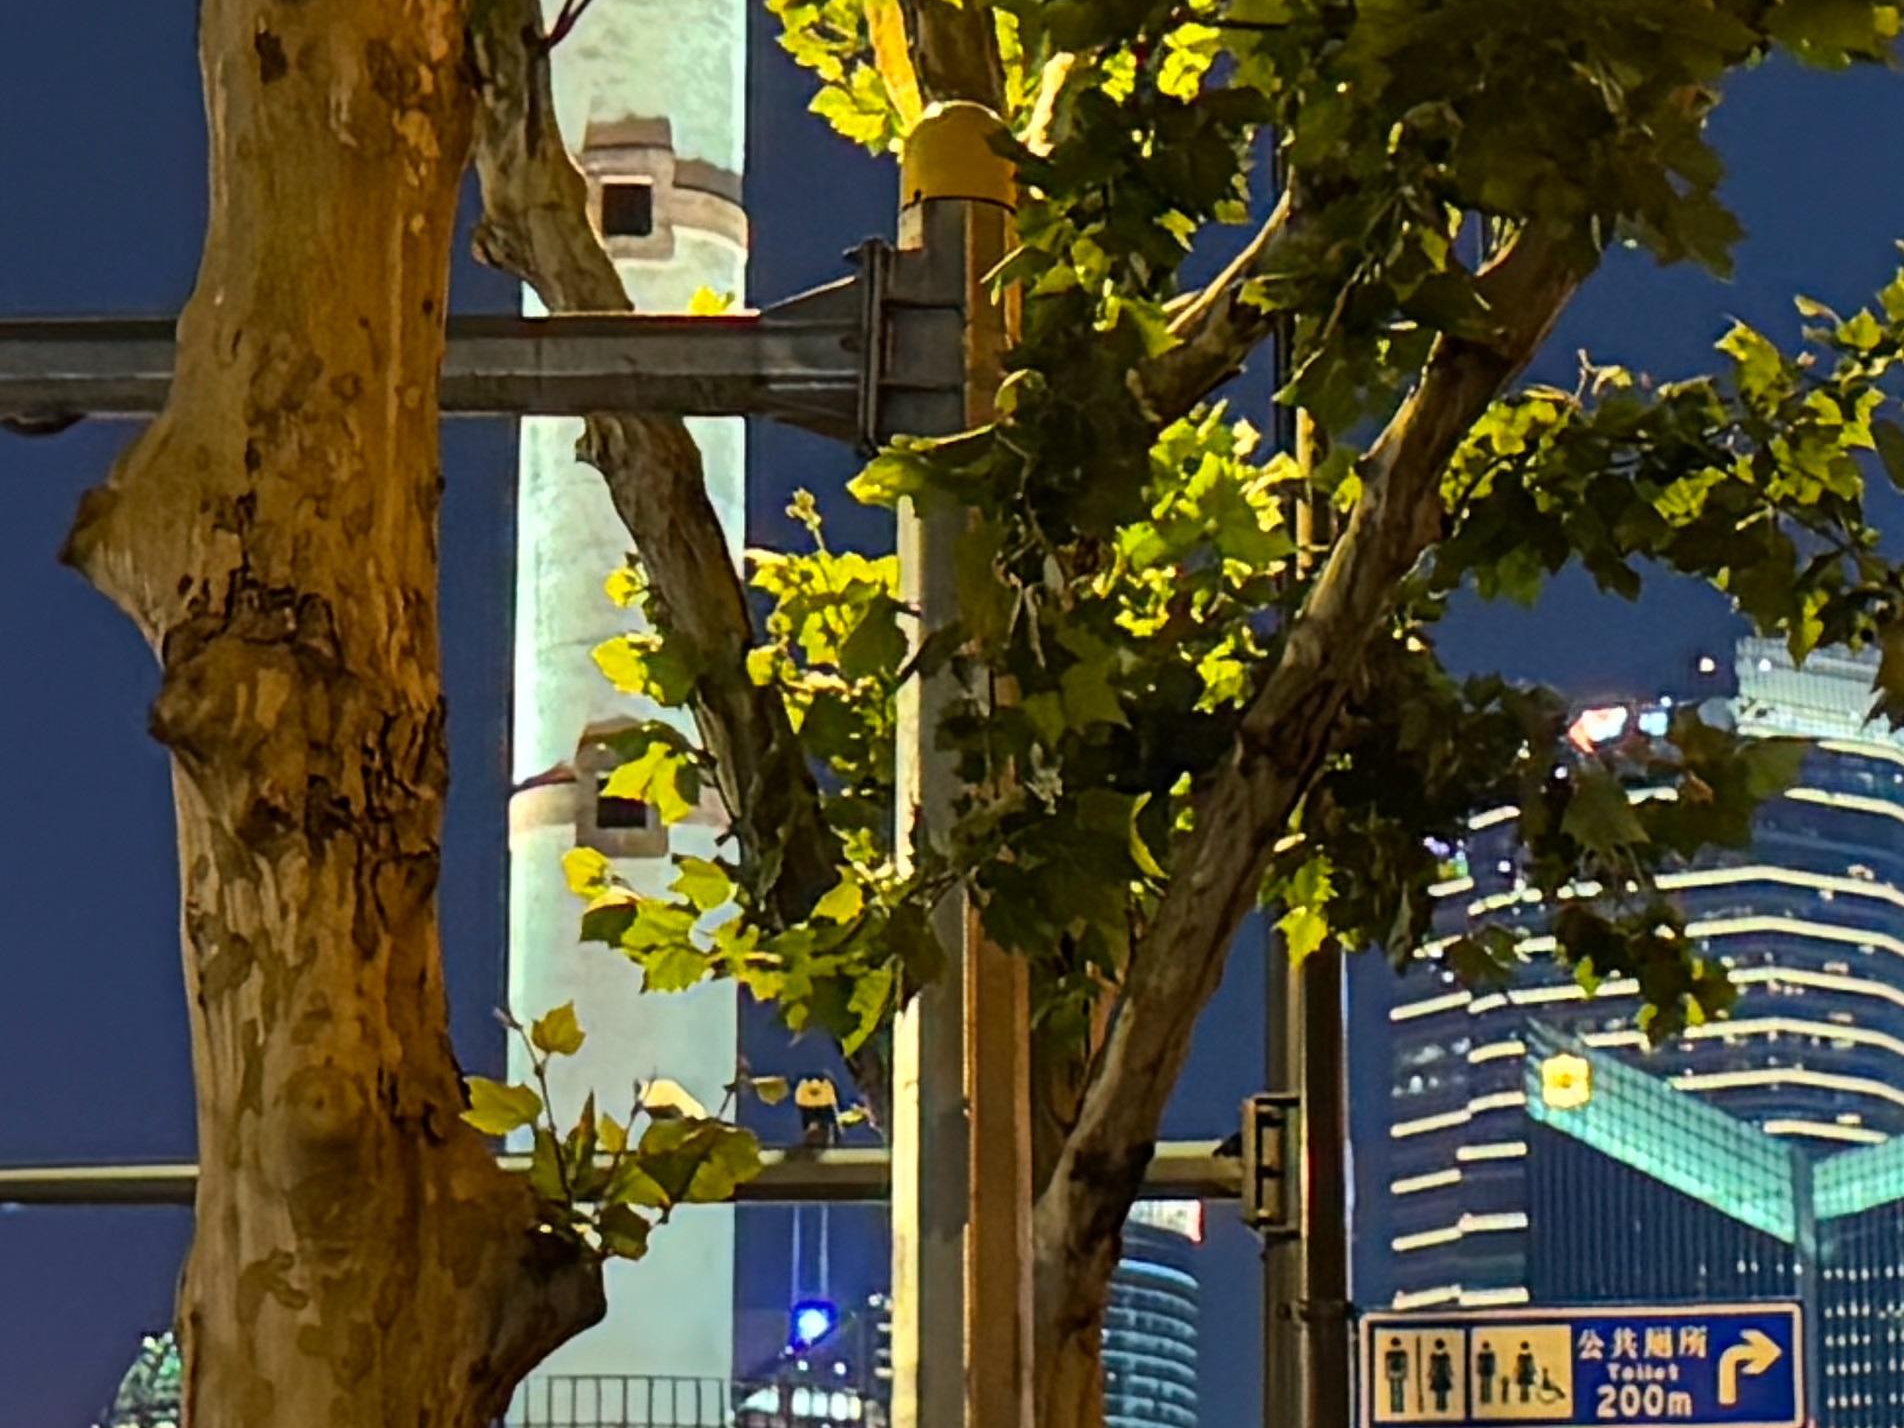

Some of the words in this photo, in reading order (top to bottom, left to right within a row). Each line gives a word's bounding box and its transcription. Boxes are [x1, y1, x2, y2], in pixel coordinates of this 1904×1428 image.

[1578, 1326, 1708, 1360] 公共厕所
[1607, 1363, 1679, 1382] Toilet
[1597, 1383, 1692, 1418] 200m
